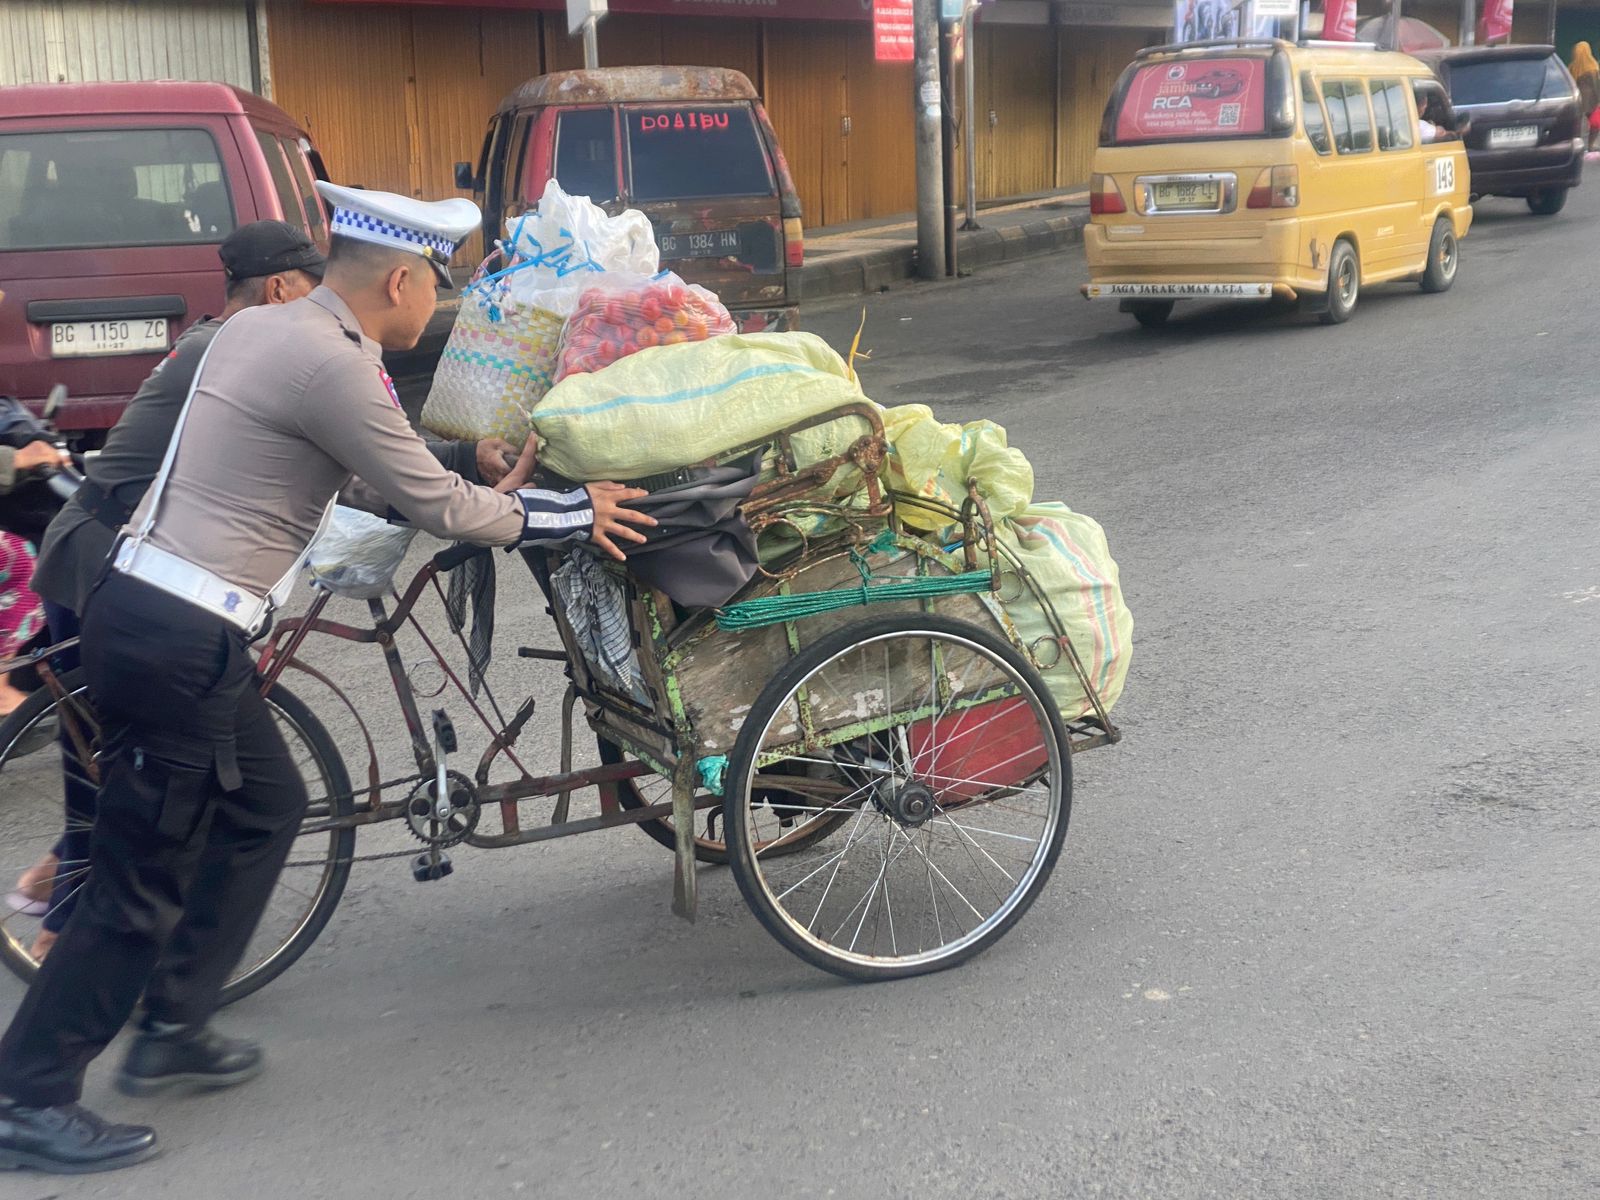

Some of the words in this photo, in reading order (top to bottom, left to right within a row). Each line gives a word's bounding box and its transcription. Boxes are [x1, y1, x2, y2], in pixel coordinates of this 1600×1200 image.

[1157, 80, 1197, 96] jambu
[1152, 96, 1193, 110] RCA
[1437, 160, 1454, 190] 143
[662, 236, 677, 251] BG
[688, 234, 714, 249] 1384
[721, 231, 738, 247] HN
[1111, 284, 1135, 294] JAGA
[1139, 284, 1176, 294] JARAK
[1178, 284, 1210, 294] AMAN
[54, 325, 75, 343] BG
[89, 322, 129, 342] 1150
[144, 320, 165, 339] ZC
